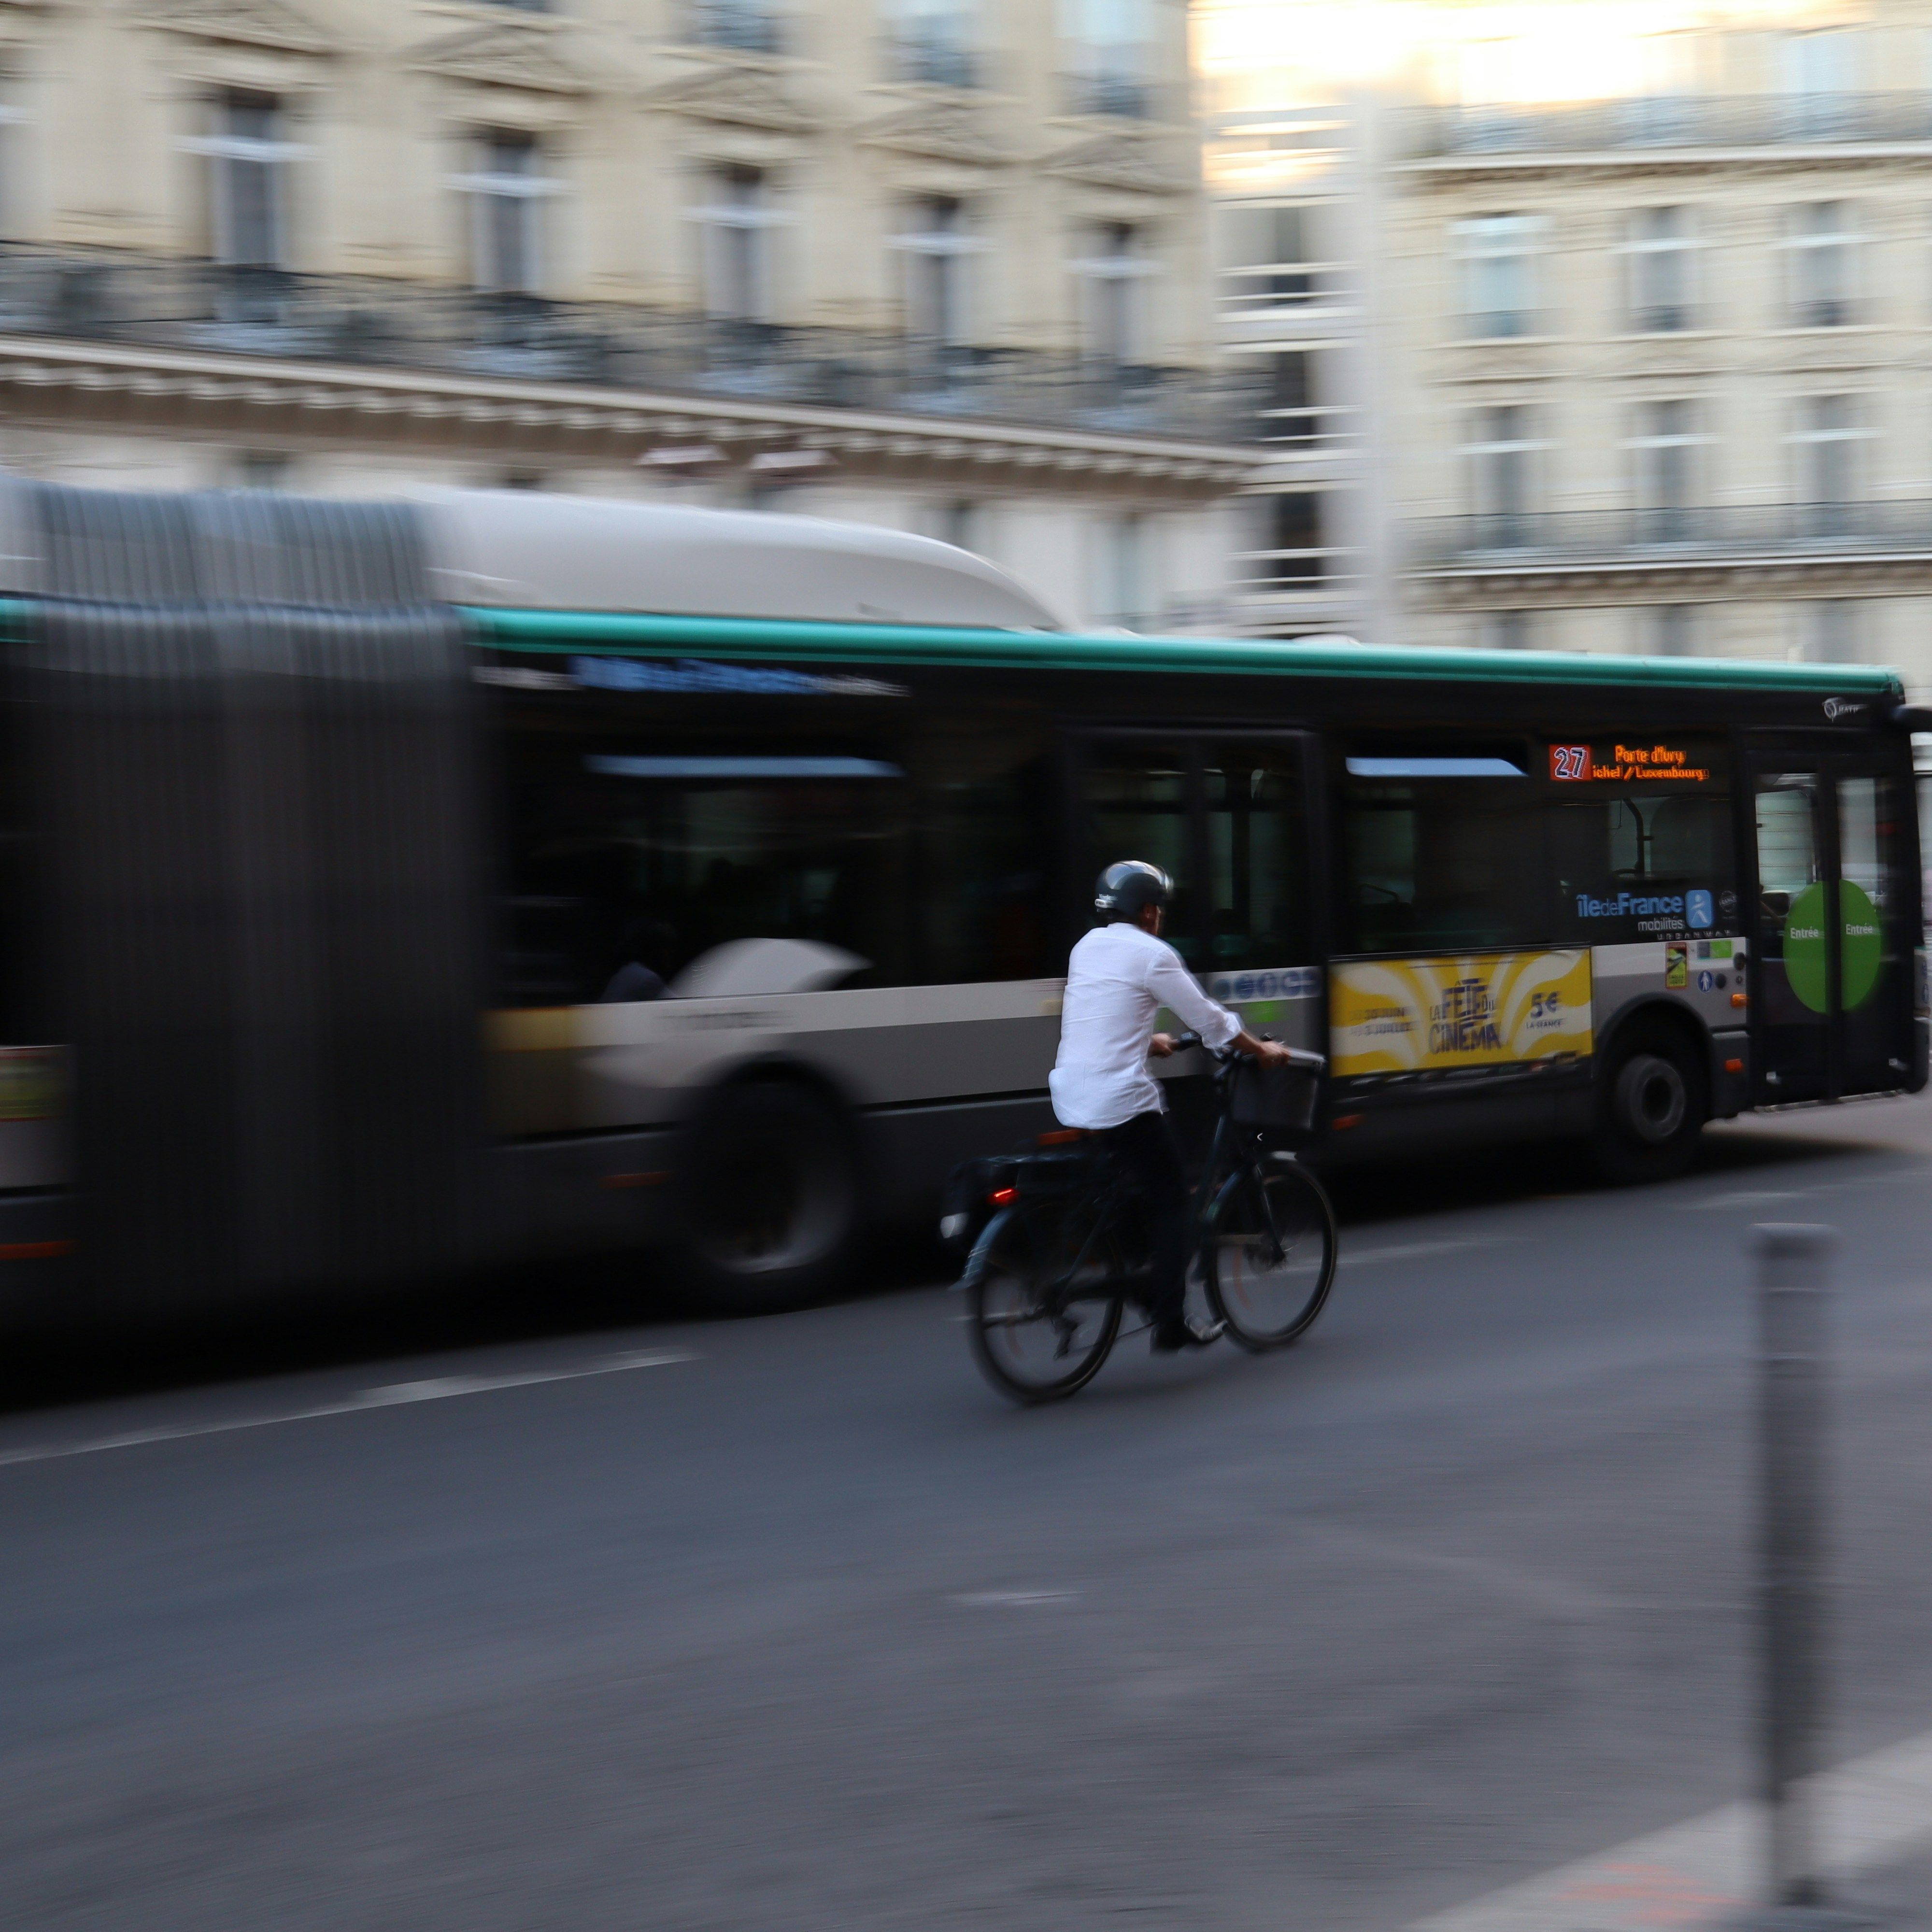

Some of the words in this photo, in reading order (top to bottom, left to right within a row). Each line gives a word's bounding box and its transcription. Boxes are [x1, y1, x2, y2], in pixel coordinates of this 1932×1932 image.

[1615, 745, 1648, 763] Porte
[1554, 746, 1587, 779] 27
[1638, 916, 1684, 931] mobilités
[1846, 923, 1873, 935] Entrée
[1790, 926, 1818, 938] Entrée
